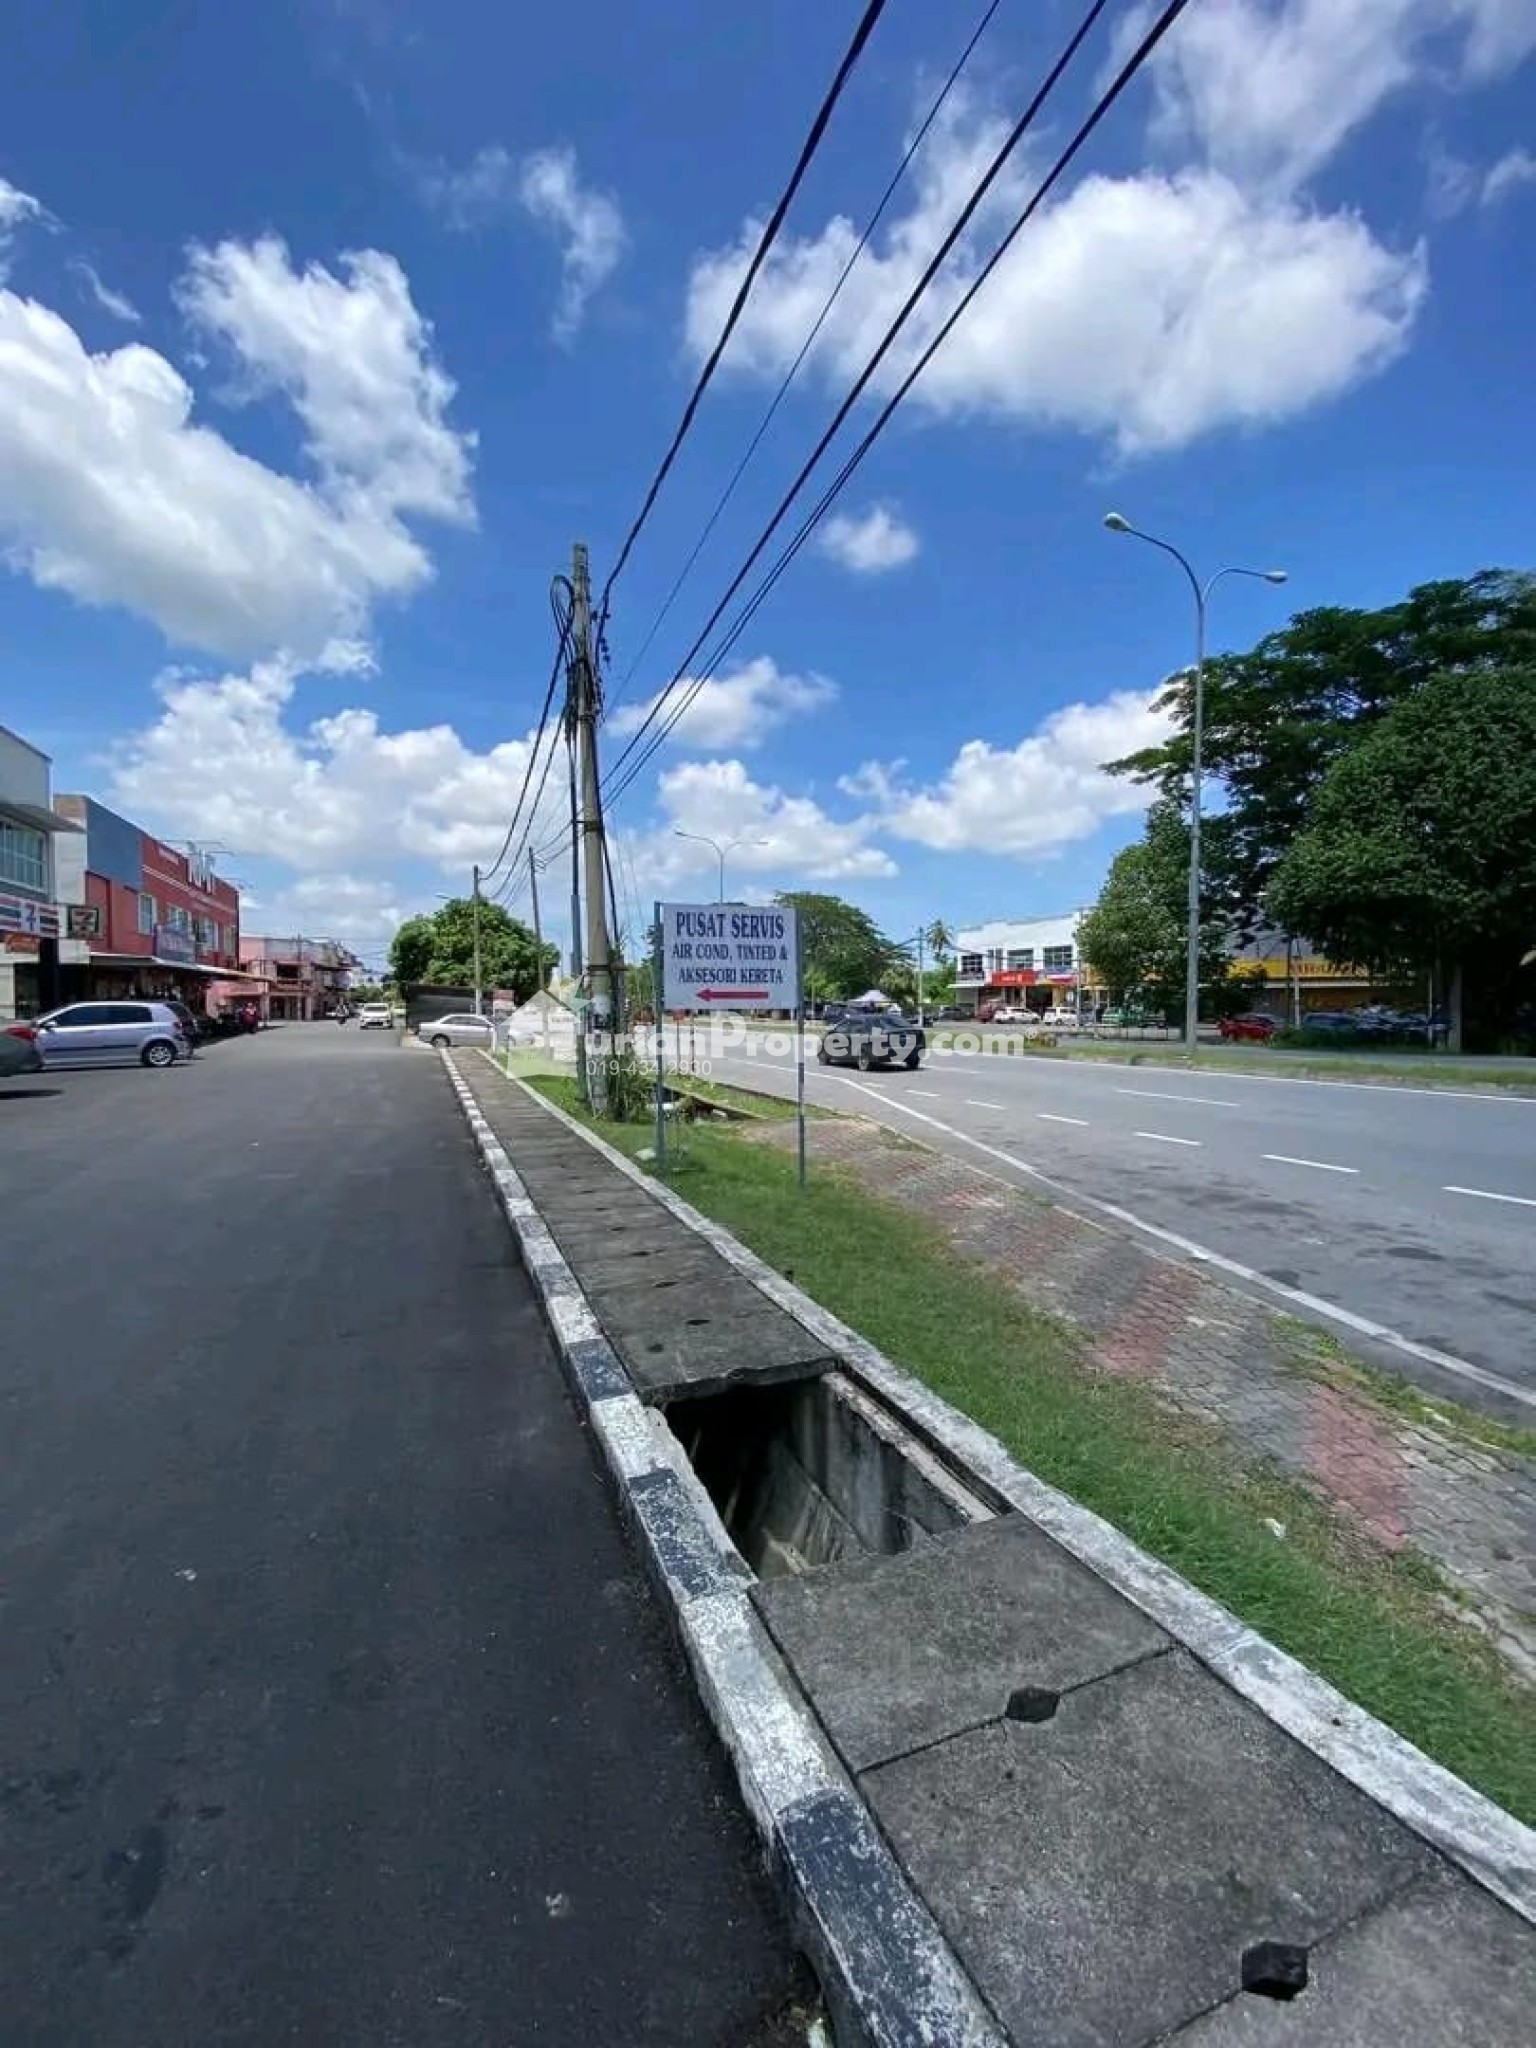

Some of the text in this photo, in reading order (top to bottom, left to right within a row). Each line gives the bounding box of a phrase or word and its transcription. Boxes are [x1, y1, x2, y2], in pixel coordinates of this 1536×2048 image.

[676, 911, 784, 939] PUSAT SERVIS
[672, 942, 692, 959] AIR
[736, 944, 776, 960] TINTED
[779, 945, 788, 960] &
[679, 967, 784, 983] AKSESORI KERETA
